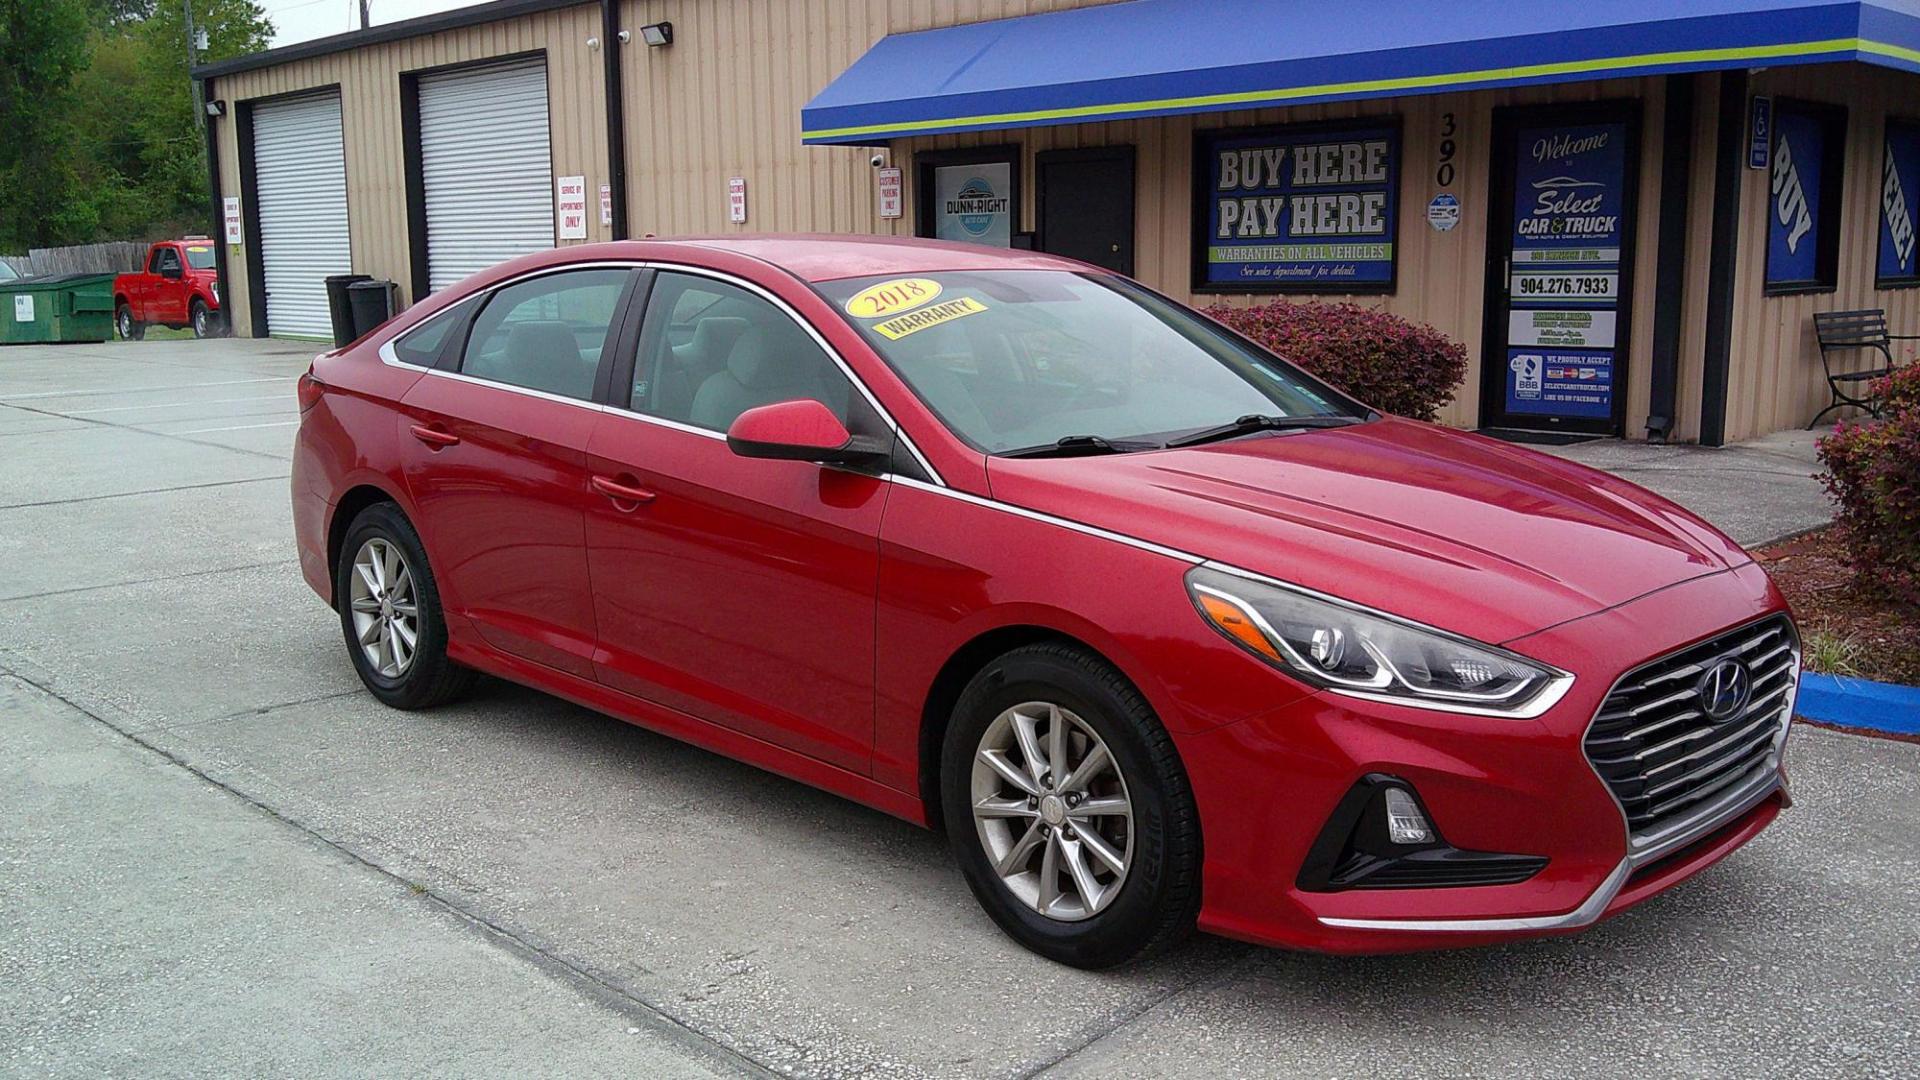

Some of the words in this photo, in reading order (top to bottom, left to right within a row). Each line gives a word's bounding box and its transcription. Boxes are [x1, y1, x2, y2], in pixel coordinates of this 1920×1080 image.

[1437, 112, 1456, 187] 390
[1532, 132, 1608, 163] Welcome
[1219, 148, 1285, 189] BUY
[1292, 142, 1387, 185] HERE
[561, 186, 575, 194] SERVICE
[1772, 133, 1812, 255] BUY
[560, 202, 584, 210] APPOINTMENT
[946, 198, 1008, 214] DUNN-RIGHT
[1533, 190, 1602, 215] Select
[565, 216, 581, 228] ONLY
[1218, 197, 1284, 238] PAY
[1289, 192, 1386, 236] HERE
[1518, 217, 1549, 234] CAR
[1551, 217, 1564, 233] &
[1565, 216, 1617, 232] TRUCK
[1217, 246, 1285, 261] WARRANTIES
[1288, 247, 1303, 259] ON
[1306, 246, 1326, 259] ALL
[1329, 245, 1385, 258] VEHICLES
[1240, 264, 1253, 276] See
[1254, 265, 1271, 276] sales
[1273, 264, 1313, 279] department
[1315, 264, 1328, 279] for
[1520, 278, 1609, 294] 904.276.7933
[864, 280, 927, 313] 2018
[883, 299, 972, 334] WARRANTY
[1557, 356, 1586, 364] PROUDLY
[1587, 357, 1611, 365] ACCEPT
[1519, 380, 1538, 389] BBB
